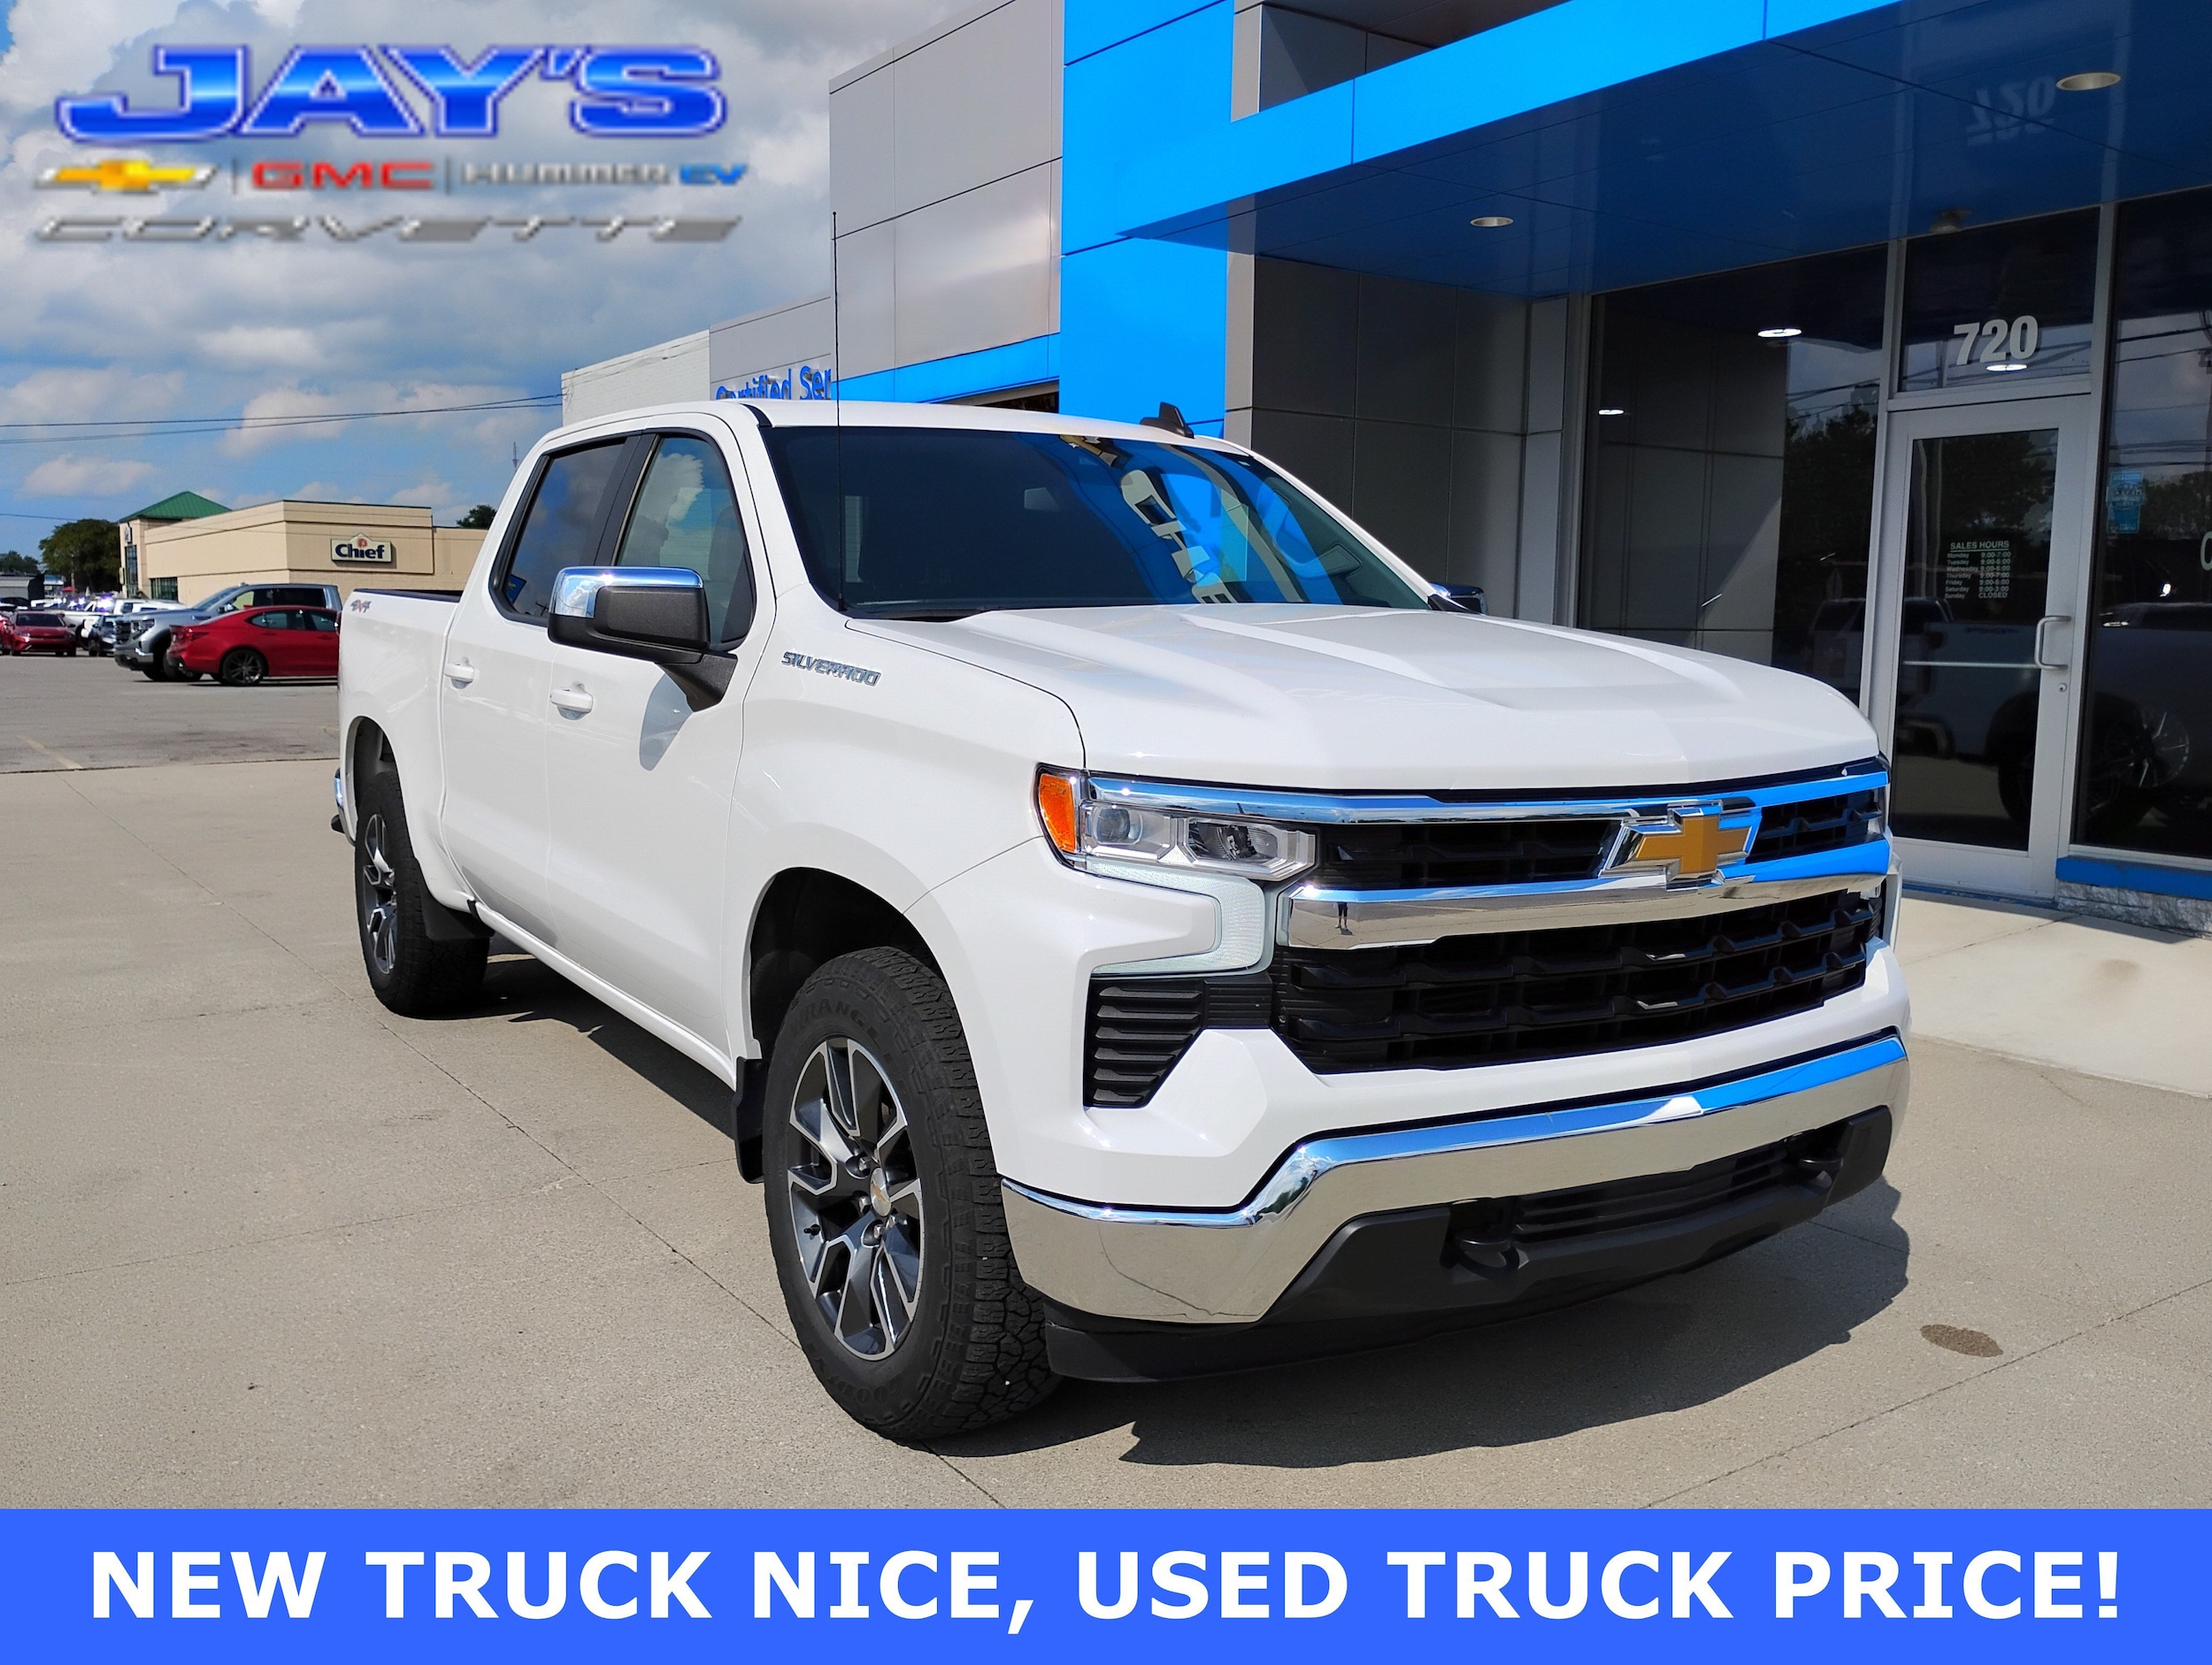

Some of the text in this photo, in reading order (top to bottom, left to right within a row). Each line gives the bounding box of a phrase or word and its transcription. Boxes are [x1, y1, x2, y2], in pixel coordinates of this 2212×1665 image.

[1953, 314, 2039, 365] 720
[334, 543, 385, 559] Chief
[781, 651, 881, 687] SILVERADO
